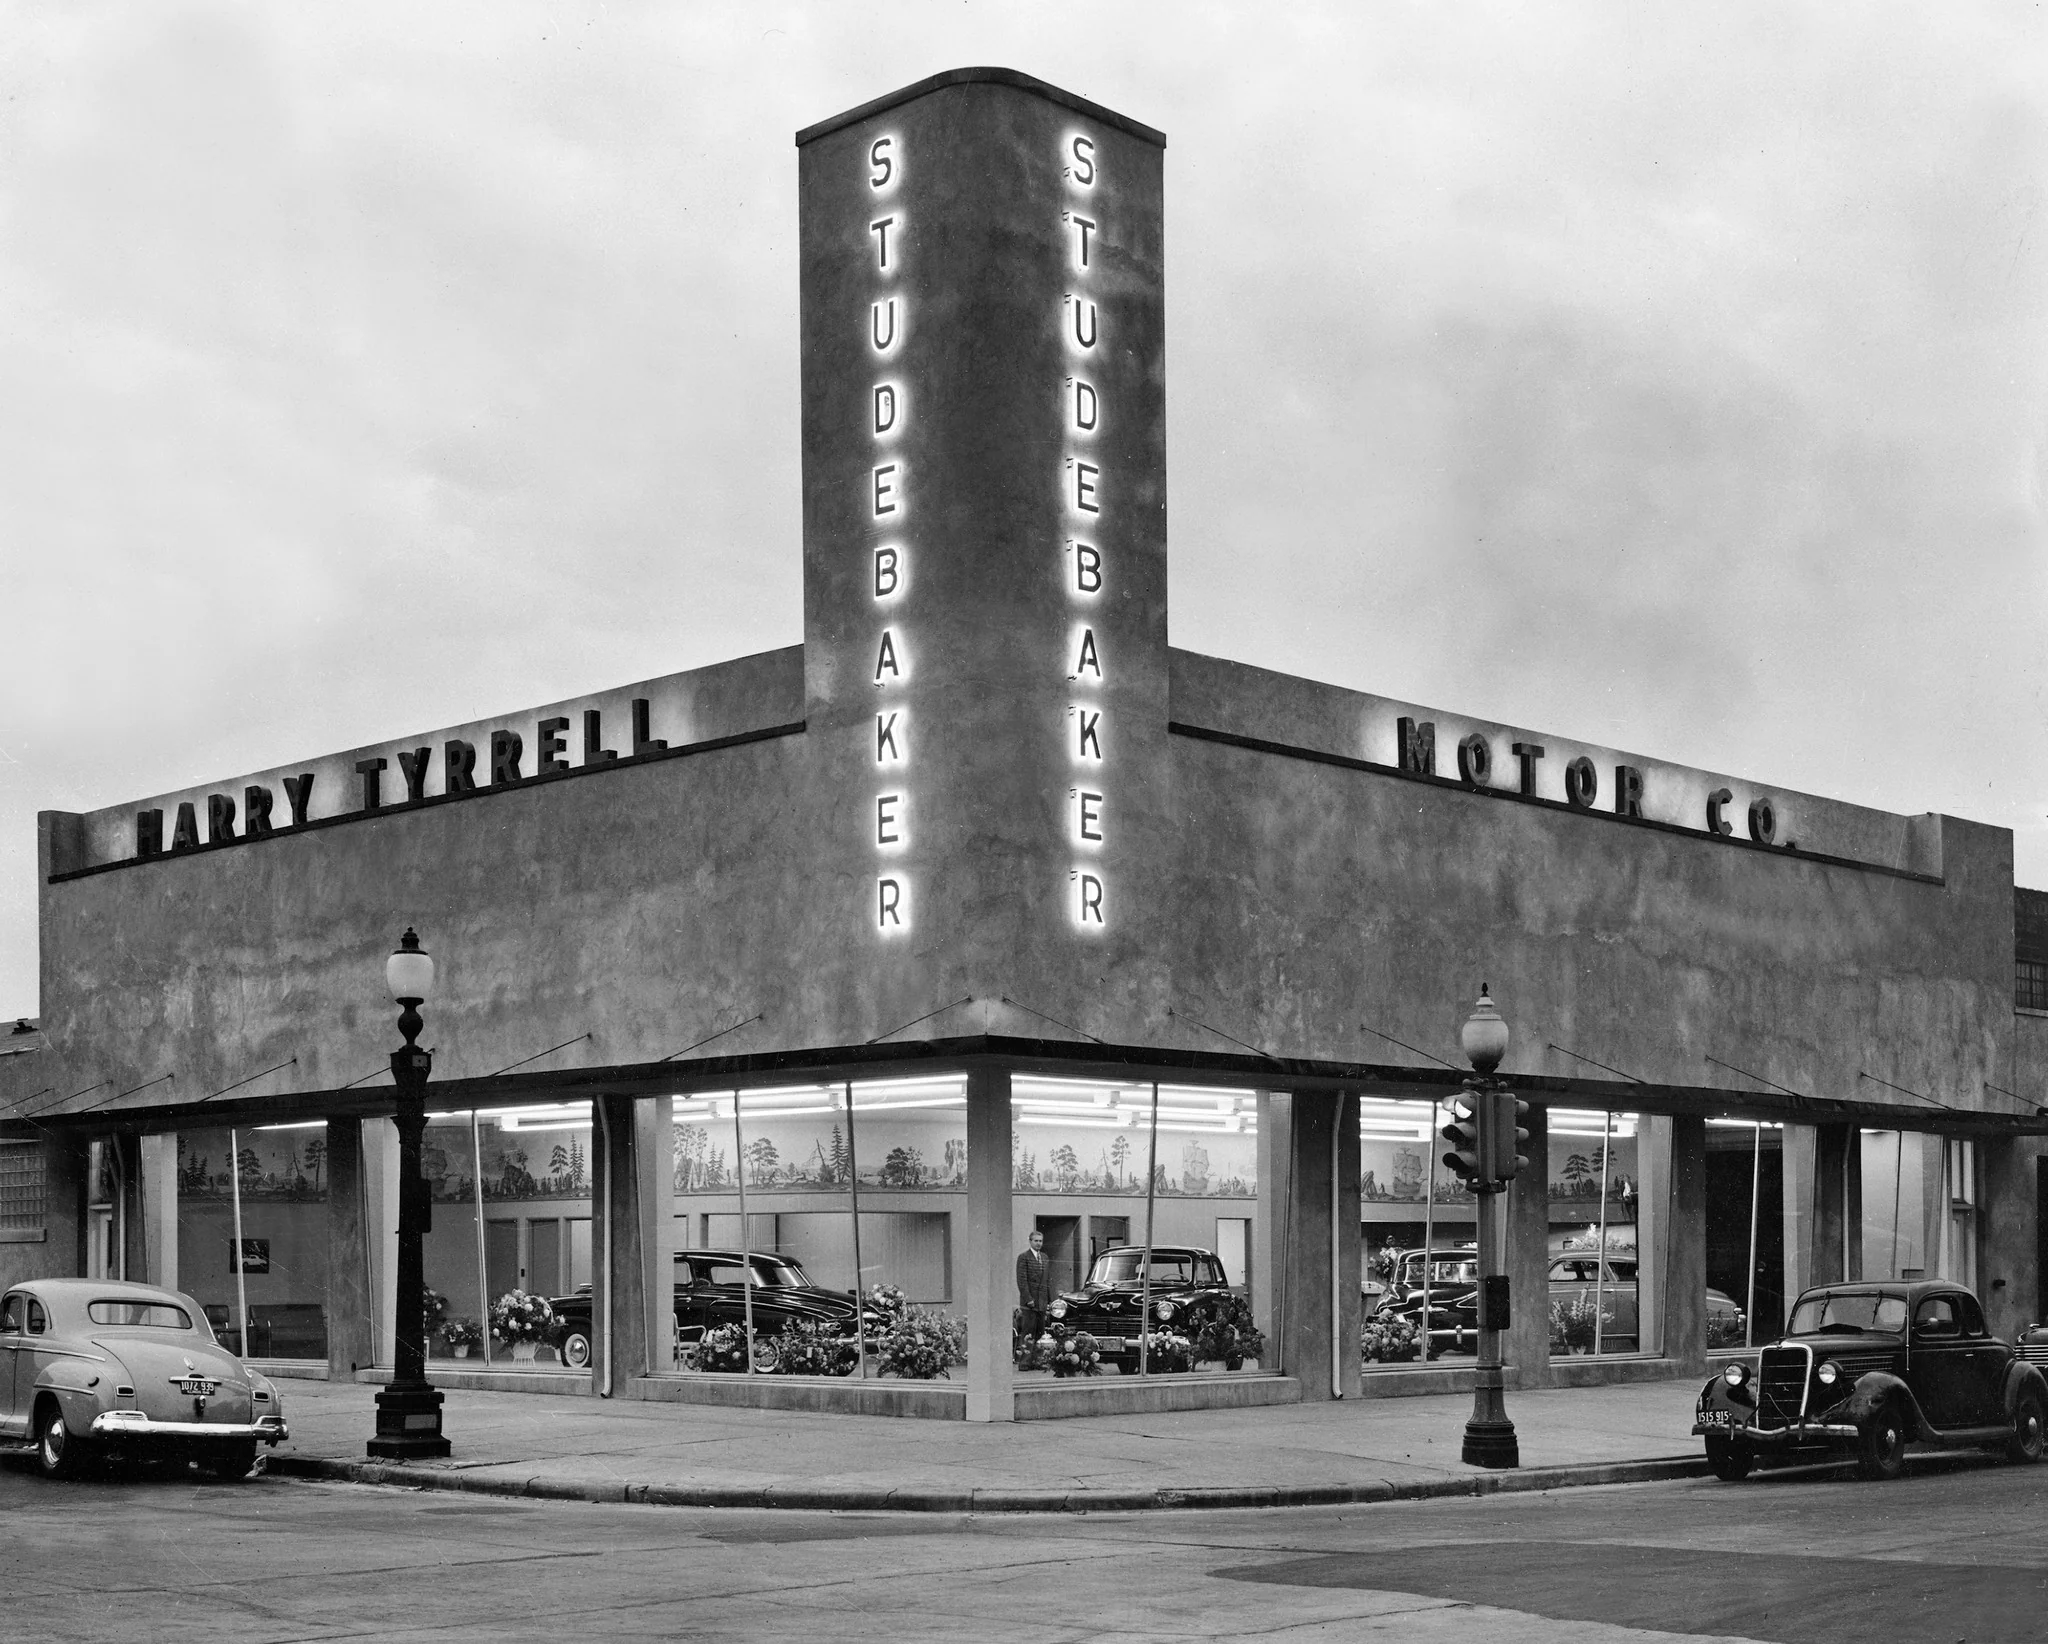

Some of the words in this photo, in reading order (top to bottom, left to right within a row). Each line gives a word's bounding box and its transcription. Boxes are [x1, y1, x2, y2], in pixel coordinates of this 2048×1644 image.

[869, 136, 902, 928] STUDEBAKER
[1072, 136, 1105, 924] STUDEBAKER
[137, 773, 315, 855] HARRY
[356, 698, 668, 809] TYRRELL
[1397, 716, 1645, 818] MOTOR
[1698, 1412, 1714, 1423] 1515
[1716, 1411, 1729, 1421] 915
